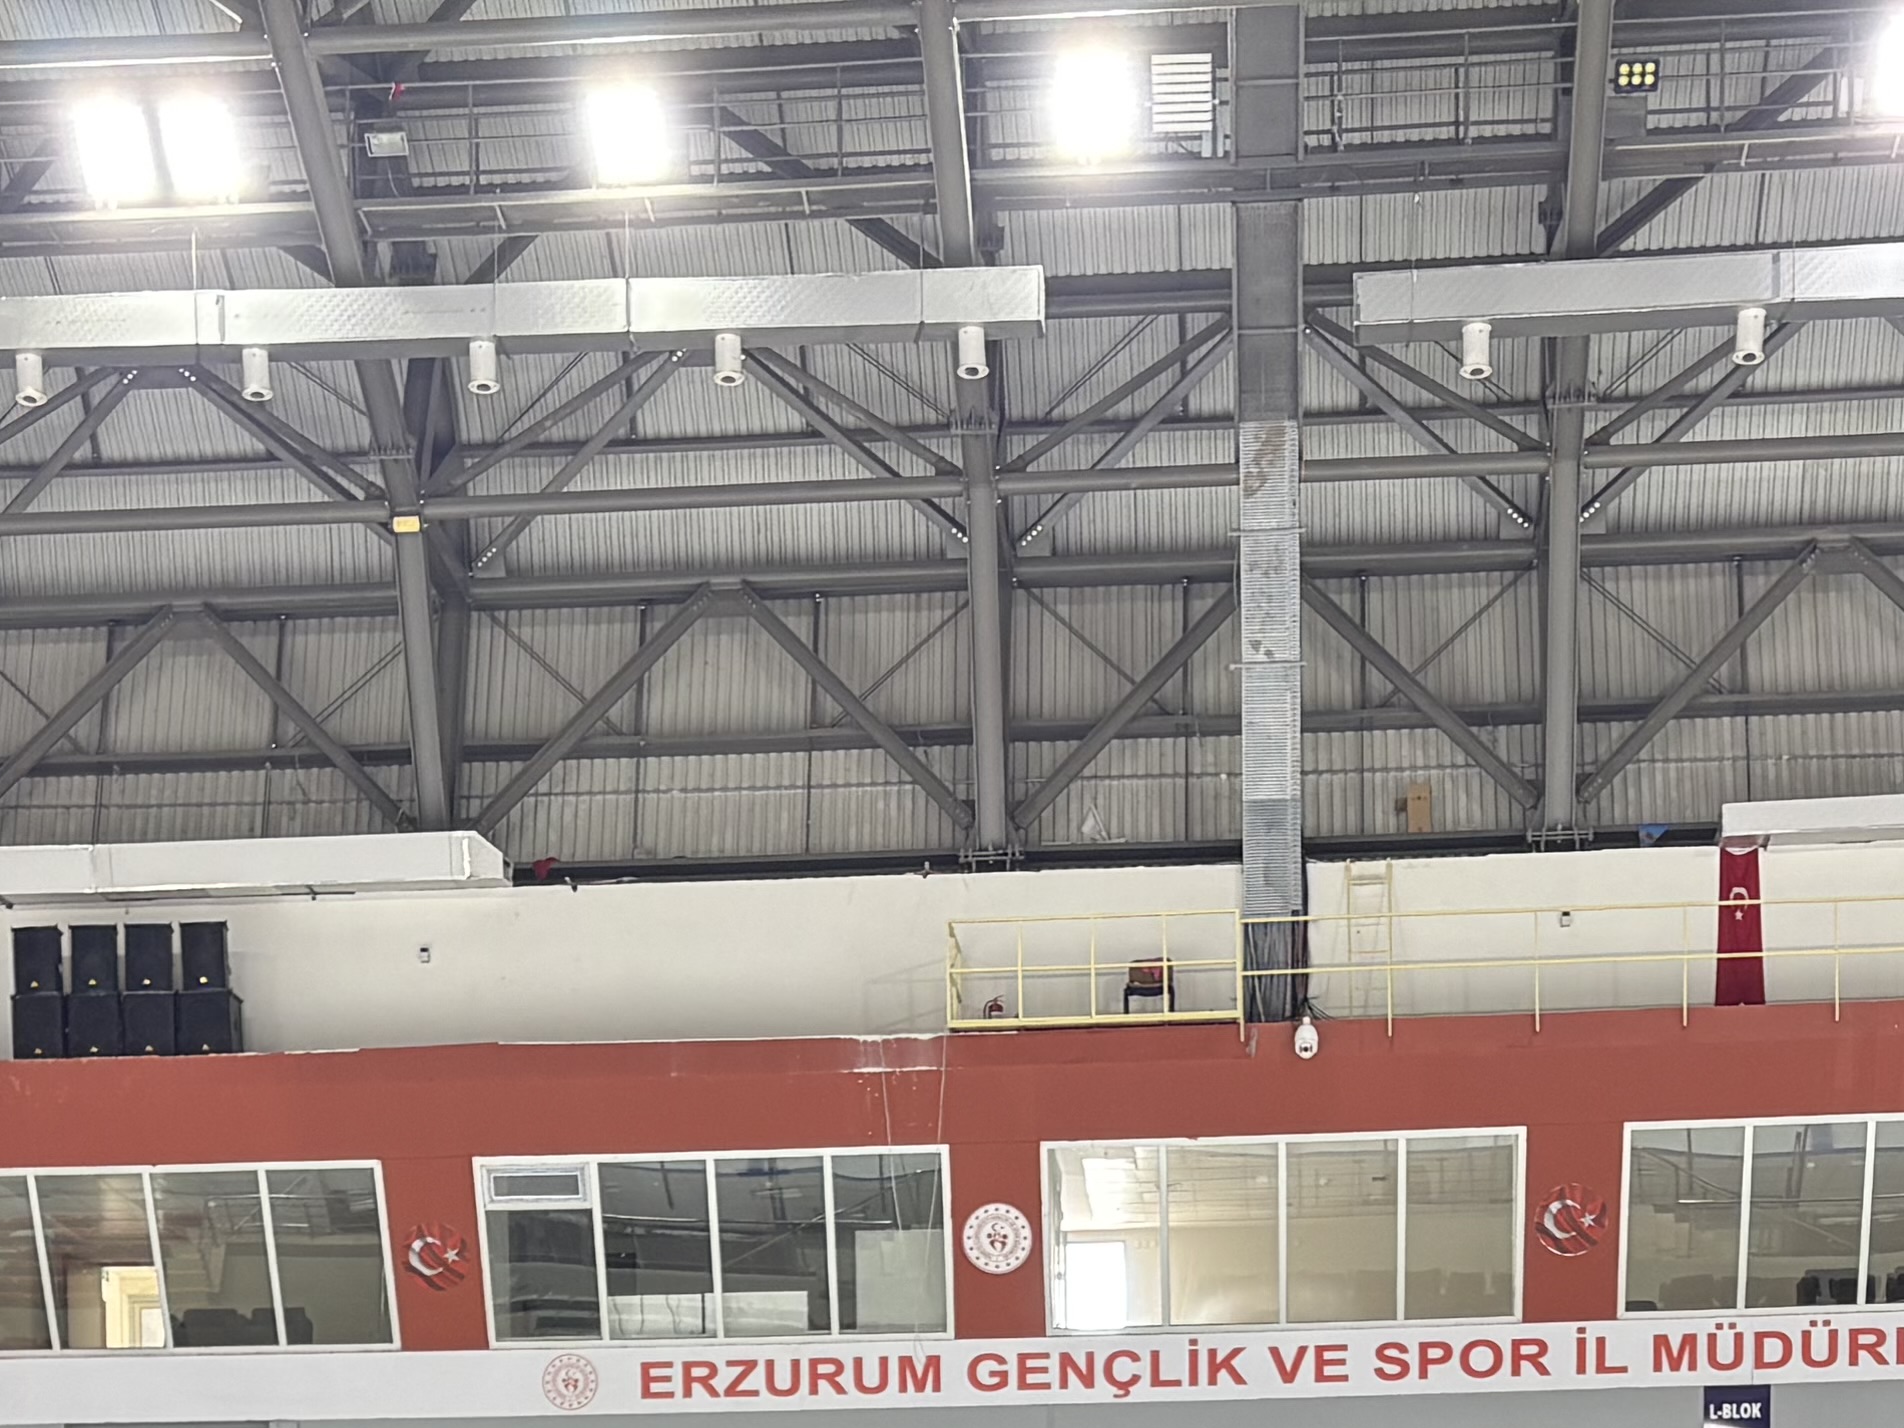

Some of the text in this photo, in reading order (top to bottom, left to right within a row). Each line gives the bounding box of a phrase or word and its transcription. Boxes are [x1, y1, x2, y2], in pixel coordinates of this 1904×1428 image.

[641, 1353, 942, 1399] ERZURUM
[968, 1338, 1245, 1398] GENÇLİK
[1269, 1344, 1350, 1384] VE
[1374, 1338, 1550, 1382] SPOR
[1576, 1326, 1628, 1375] İL
[1709, 1402, 1762, 1420] L-BLOK
